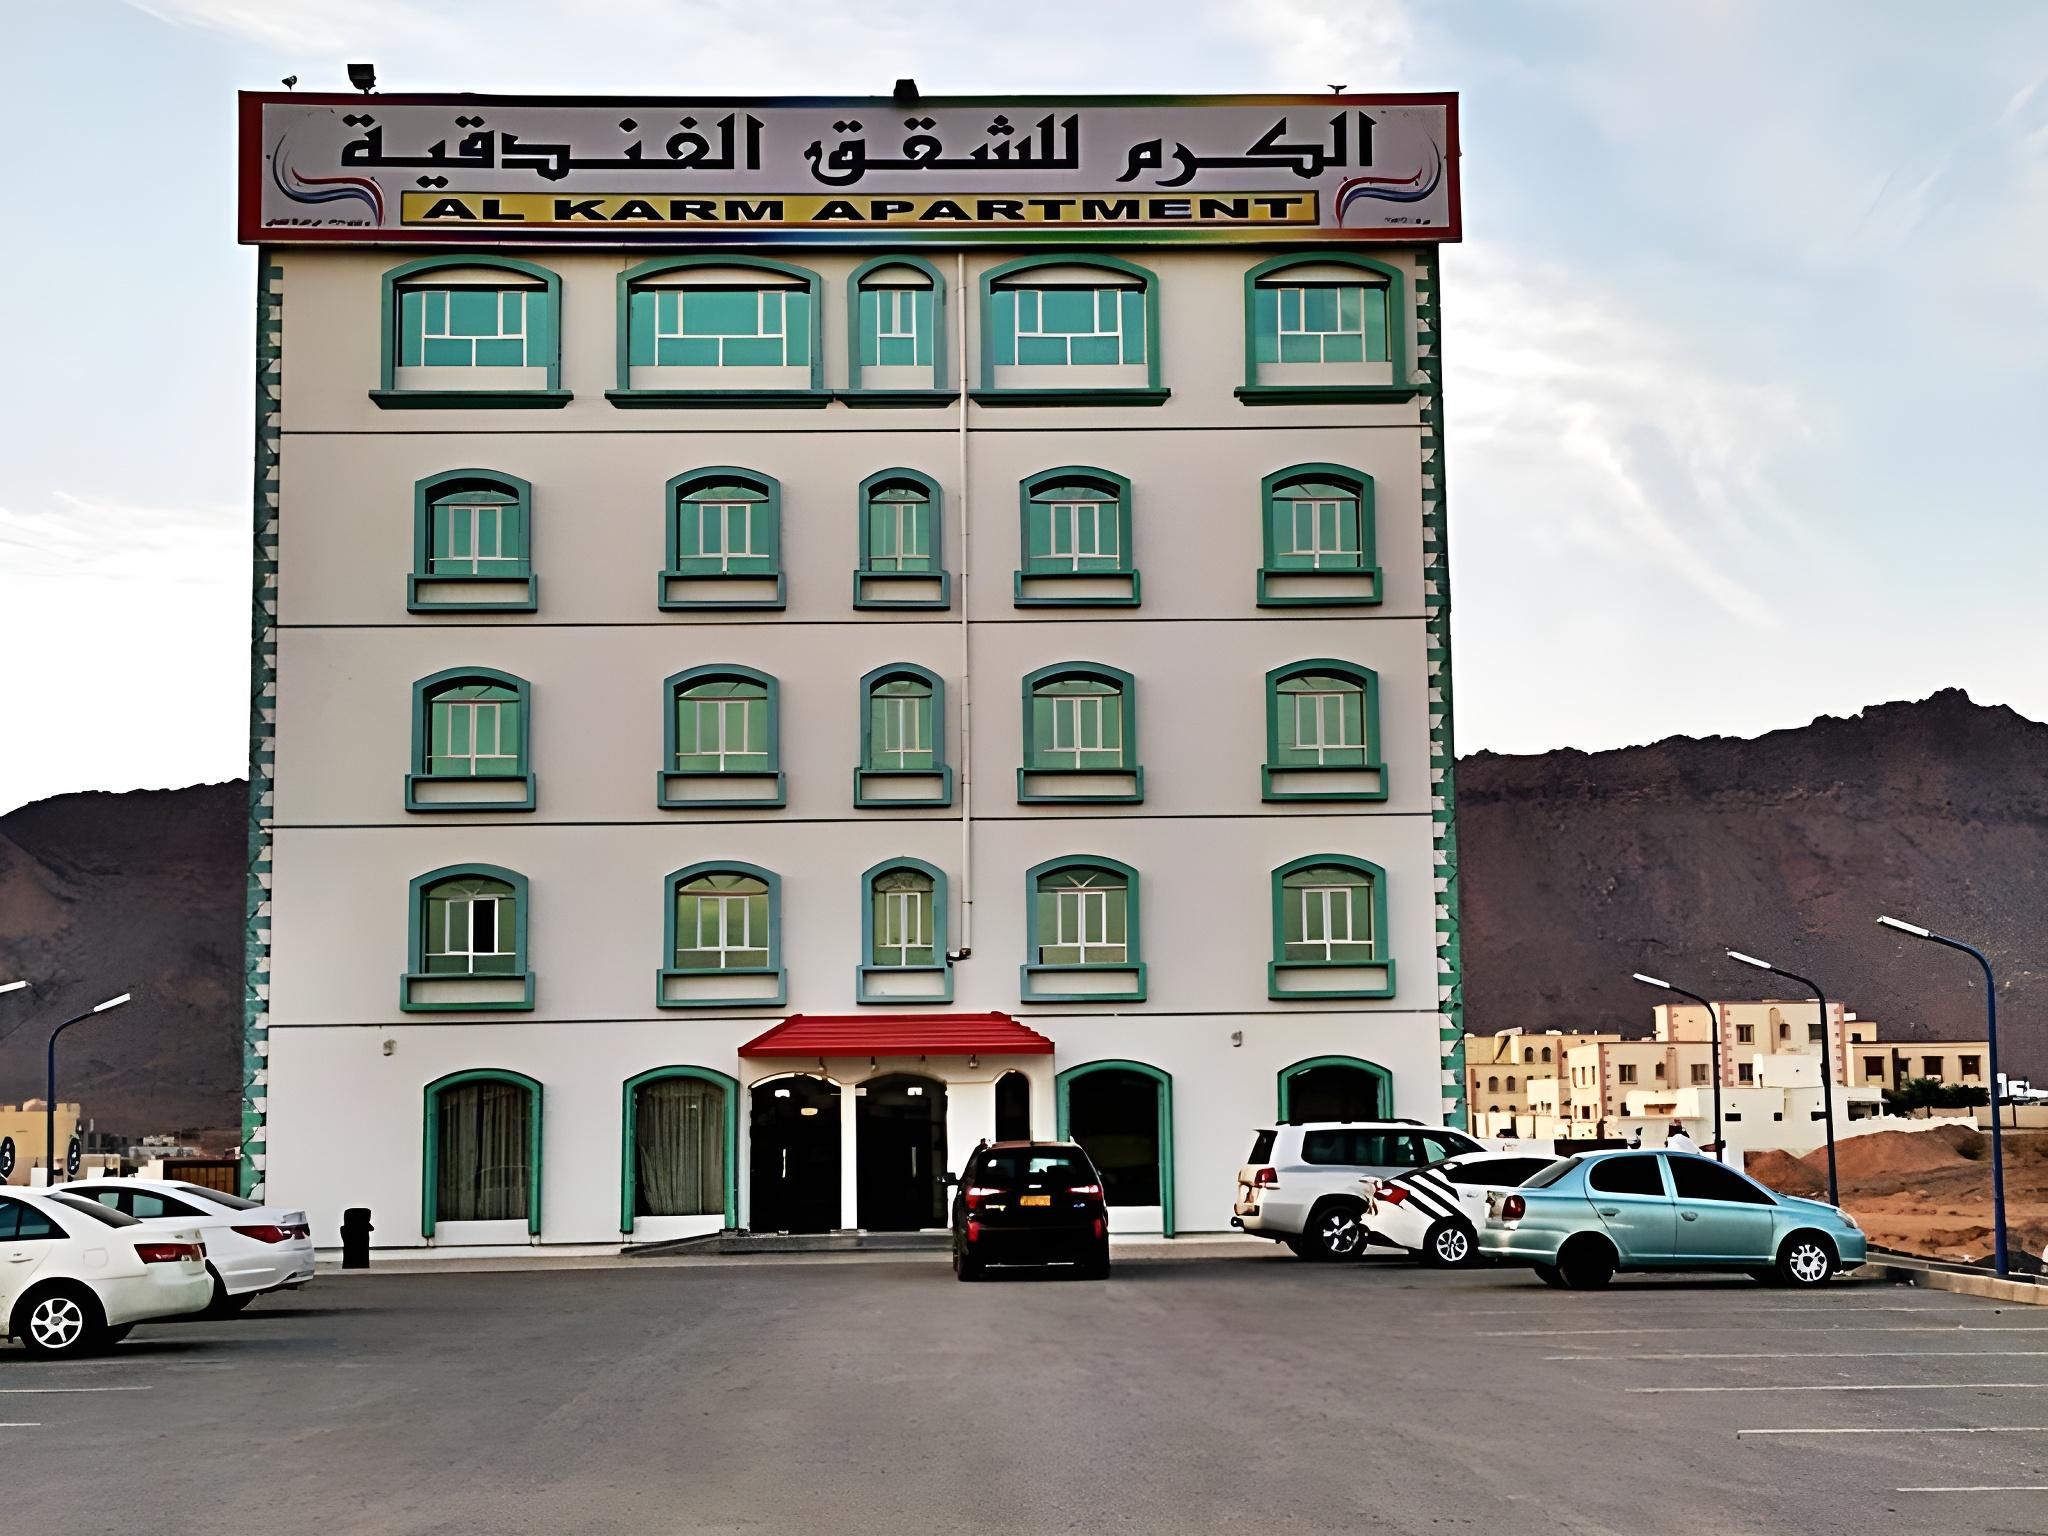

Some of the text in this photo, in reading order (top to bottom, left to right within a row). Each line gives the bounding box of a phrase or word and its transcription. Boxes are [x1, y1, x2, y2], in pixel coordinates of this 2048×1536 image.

[340, 110, 1378, 190] الكرم للشقق الفندقية
[422, 198, 1303, 221] AL KARM APARTMENT
